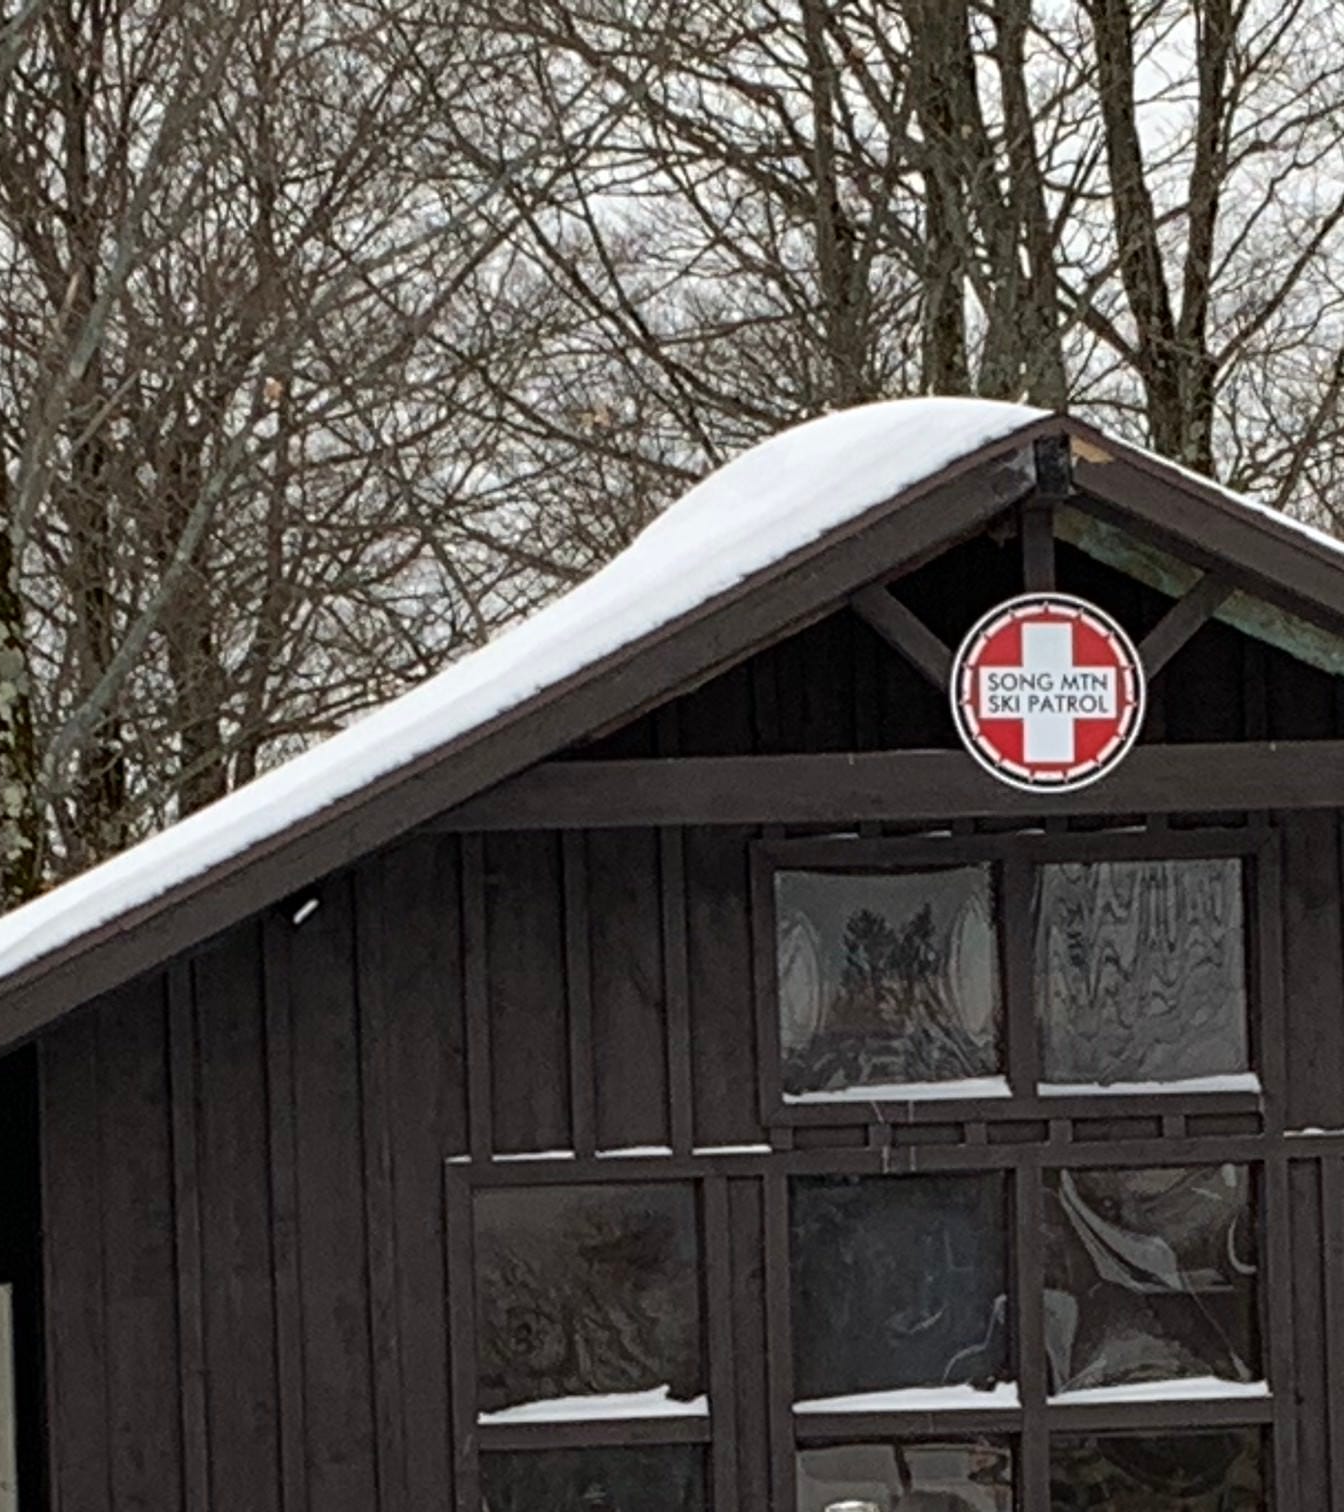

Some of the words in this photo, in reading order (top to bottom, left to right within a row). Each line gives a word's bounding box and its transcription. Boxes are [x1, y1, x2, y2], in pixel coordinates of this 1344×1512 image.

[987, 673, 1054, 691] SONG
[1060, 673, 1109, 691] MTN
[987, 695, 1020, 713] SKI
[1027, 695, 1109, 713] PATROL
